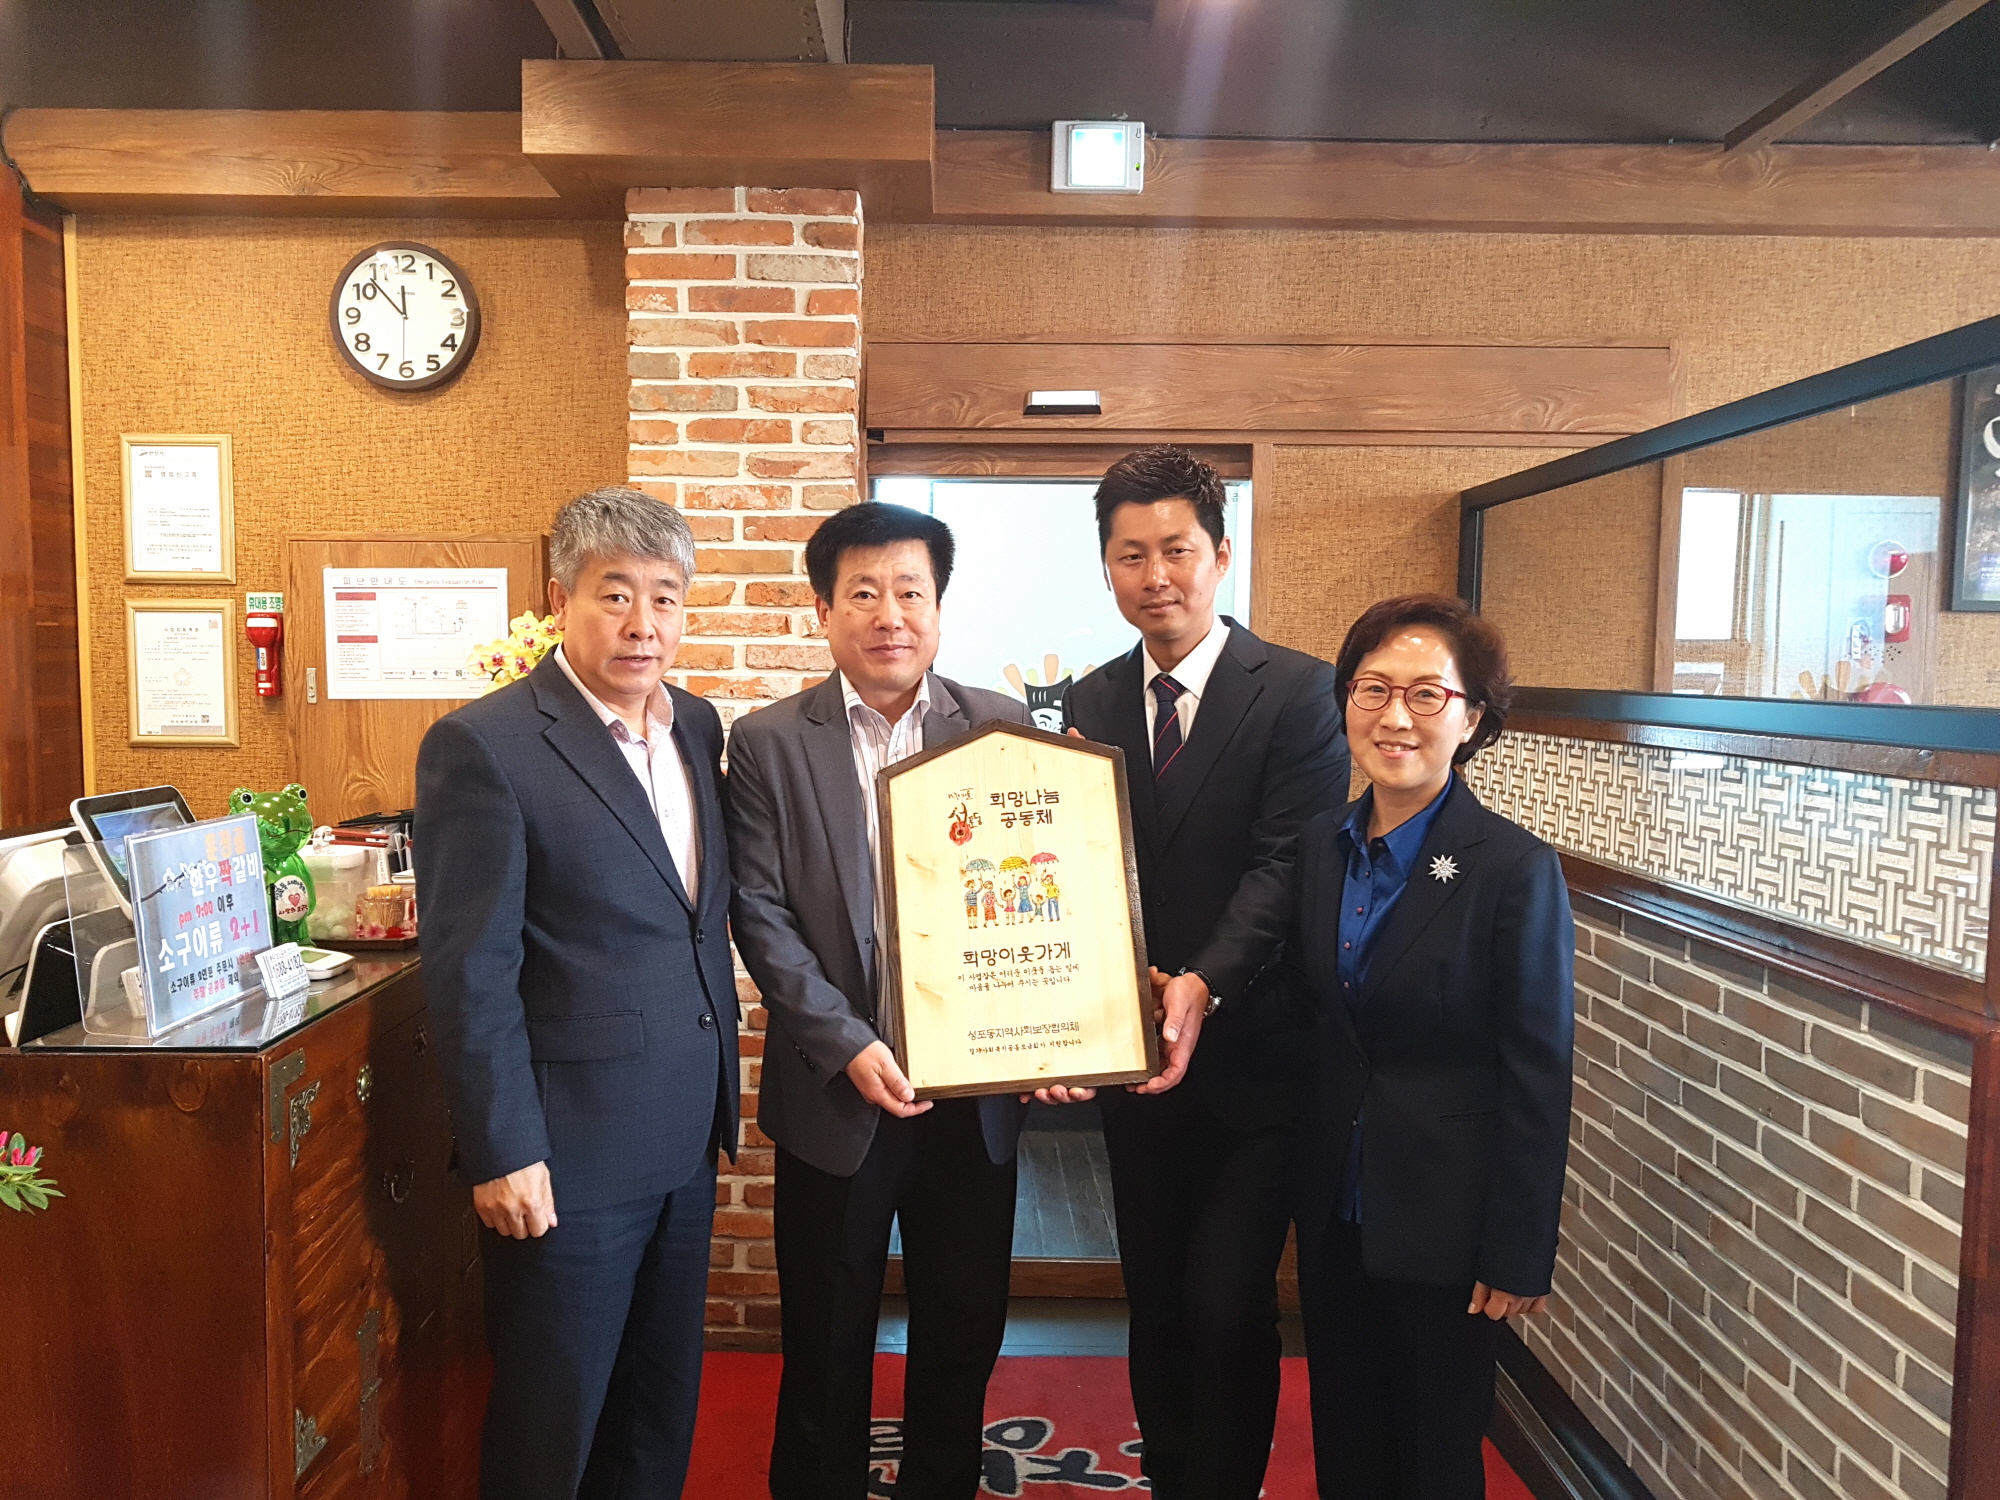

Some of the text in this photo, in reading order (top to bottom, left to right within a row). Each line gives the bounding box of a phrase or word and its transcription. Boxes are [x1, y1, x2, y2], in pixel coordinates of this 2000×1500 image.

[425, 262, 433, 280] 1
[352, 282, 378, 301] 10
[441, 279, 457, 298] 2
[345, 306, 361, 325] 9
[451, 307, 465, 326] 3
[354, 332, 371, 352] 8
[440, 333, 457, 352] 4
[376, 353, 390, 370] 7
[399, 360, 415, 378] 6
[426, 354, 440, 371] 5
[249, 596, 284, 610] 휴대용 조명
[990, 788, 1060, 809] 희망나눔
[1000, 808, 1053, 829] 공동체
[178, 893, 234, 929] pm 9:00 이후
[158, 909, 259, 973] 소구이류 2+1
[962, 941, 1071, 968] 희망이웃가게
[216, 957, 234, 975] 주문시
[957, 974, 965, 982] 이
[968, 971, 997, 981] 사업장은
[999, 968, 1020, 978] 어려운
[1023, 965, 1044, 976] 이웃을
[1065, 963, 1080, 973] 일에
[969, 975, 1071, 992] 마음을 나누어 주시는 곳입니다
[967, 1021, 1080, 1041] 성포동지역사회보장협의체
